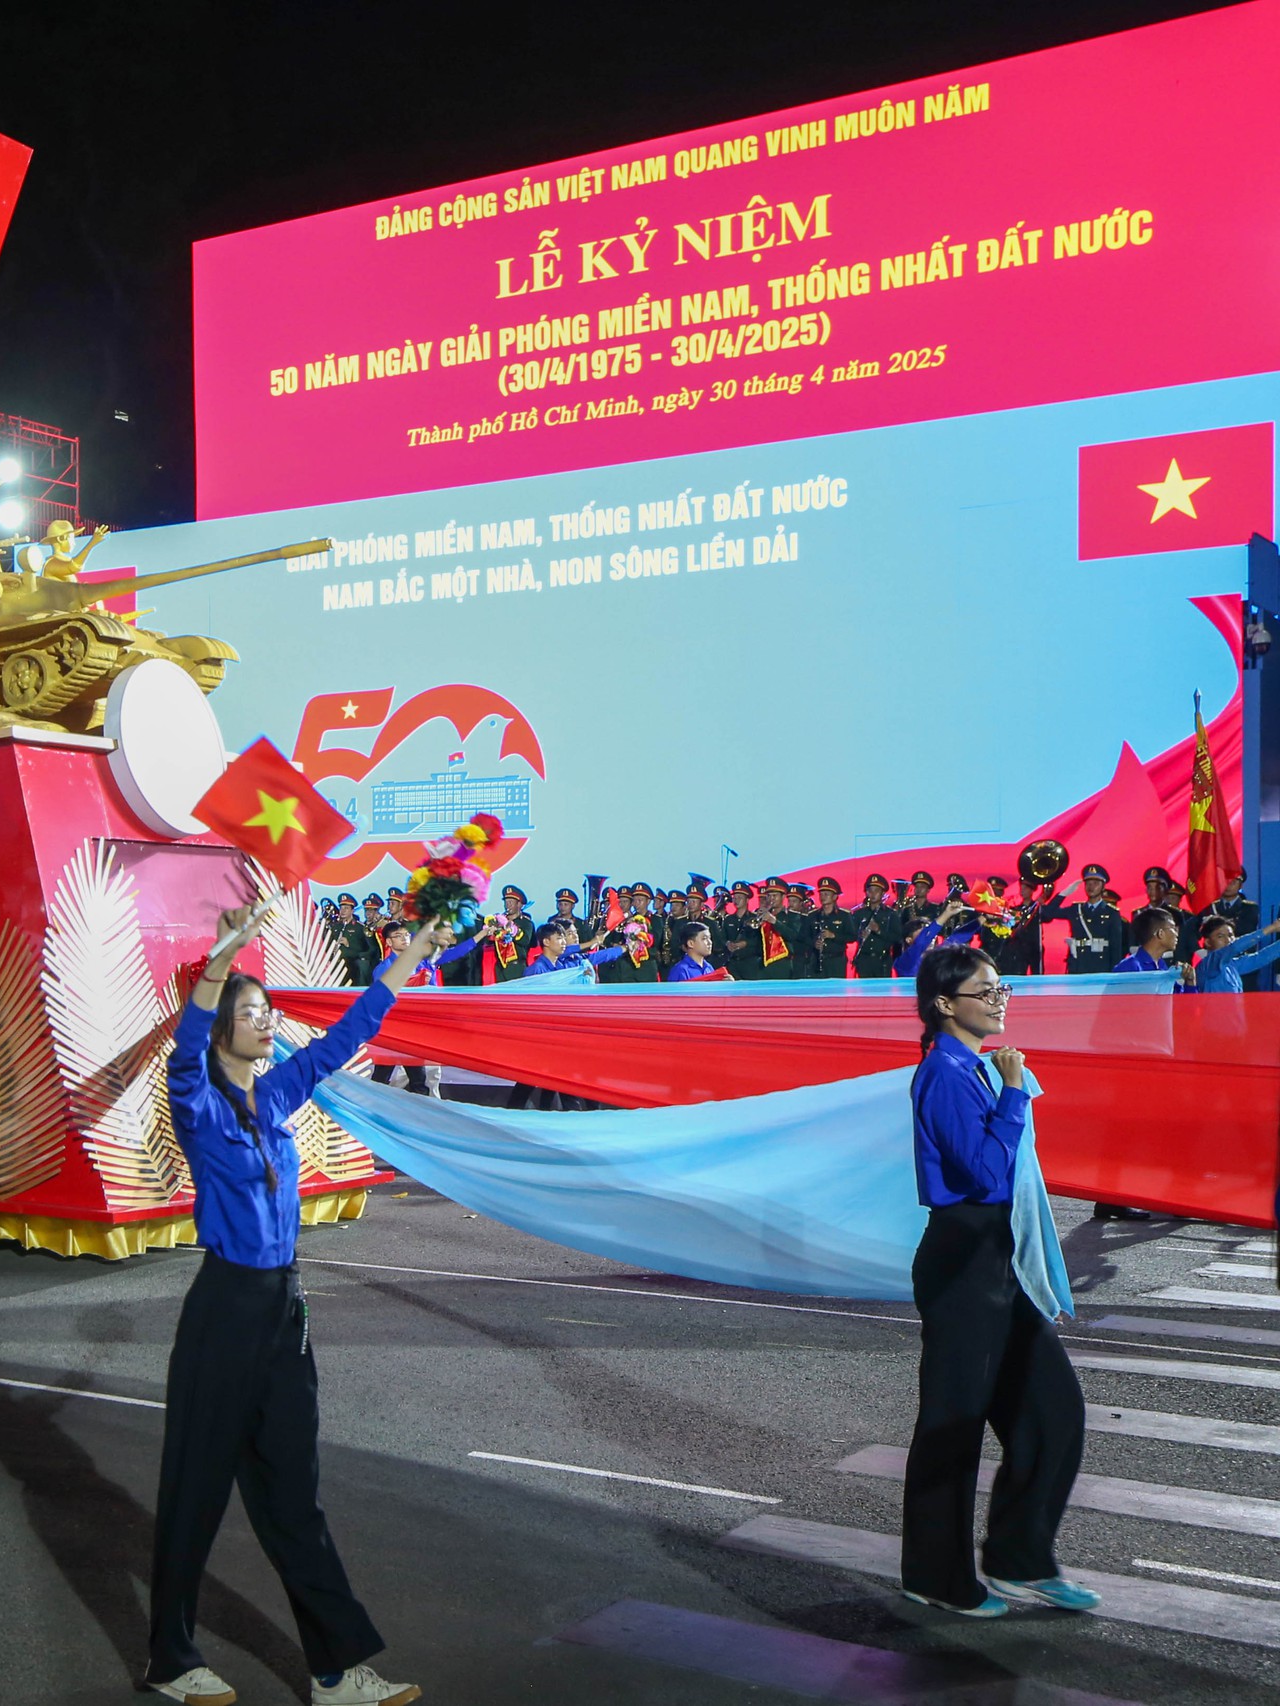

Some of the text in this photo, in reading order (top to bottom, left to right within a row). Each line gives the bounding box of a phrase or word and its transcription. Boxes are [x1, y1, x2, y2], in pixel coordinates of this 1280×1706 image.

[375, 82, 990, 241] ĐẢNG CỘNG SẢN VIỆT NAM QUANG VINH MUÔN NĂM
[495, 193, 833, 299] LỄ KỶ NIỆM
[269, 206, 1153, 397] 50 NĂM NGÀY GIẢI PHÓNG MIỀN NAM, THỐNG NHẤT ĐẤT NƯỚC
[406, 344, 948, 447] Thành phố Hồ Chí Minh, ngày 30 tháng 4 năm 2025
[497, 310, 832, 397] (30/4/1975 - 30/4/2025)
[322, 524, 799, 612] NAM BẮC MỘT NHÀ, NON SÔNG LIỀN DẢI
[332, 531, 410, 569] PHÓNG
[414, 519, 474, 559] MIỀN
[479, 517, 543, 551] NAM,
[548, 499, 631, 542] THỐNG
[637, 487, 707, 532] NHẤT
[712, 479, 765, 523] ĐẤT
[771, 474, 848, 516] NƯỚC
